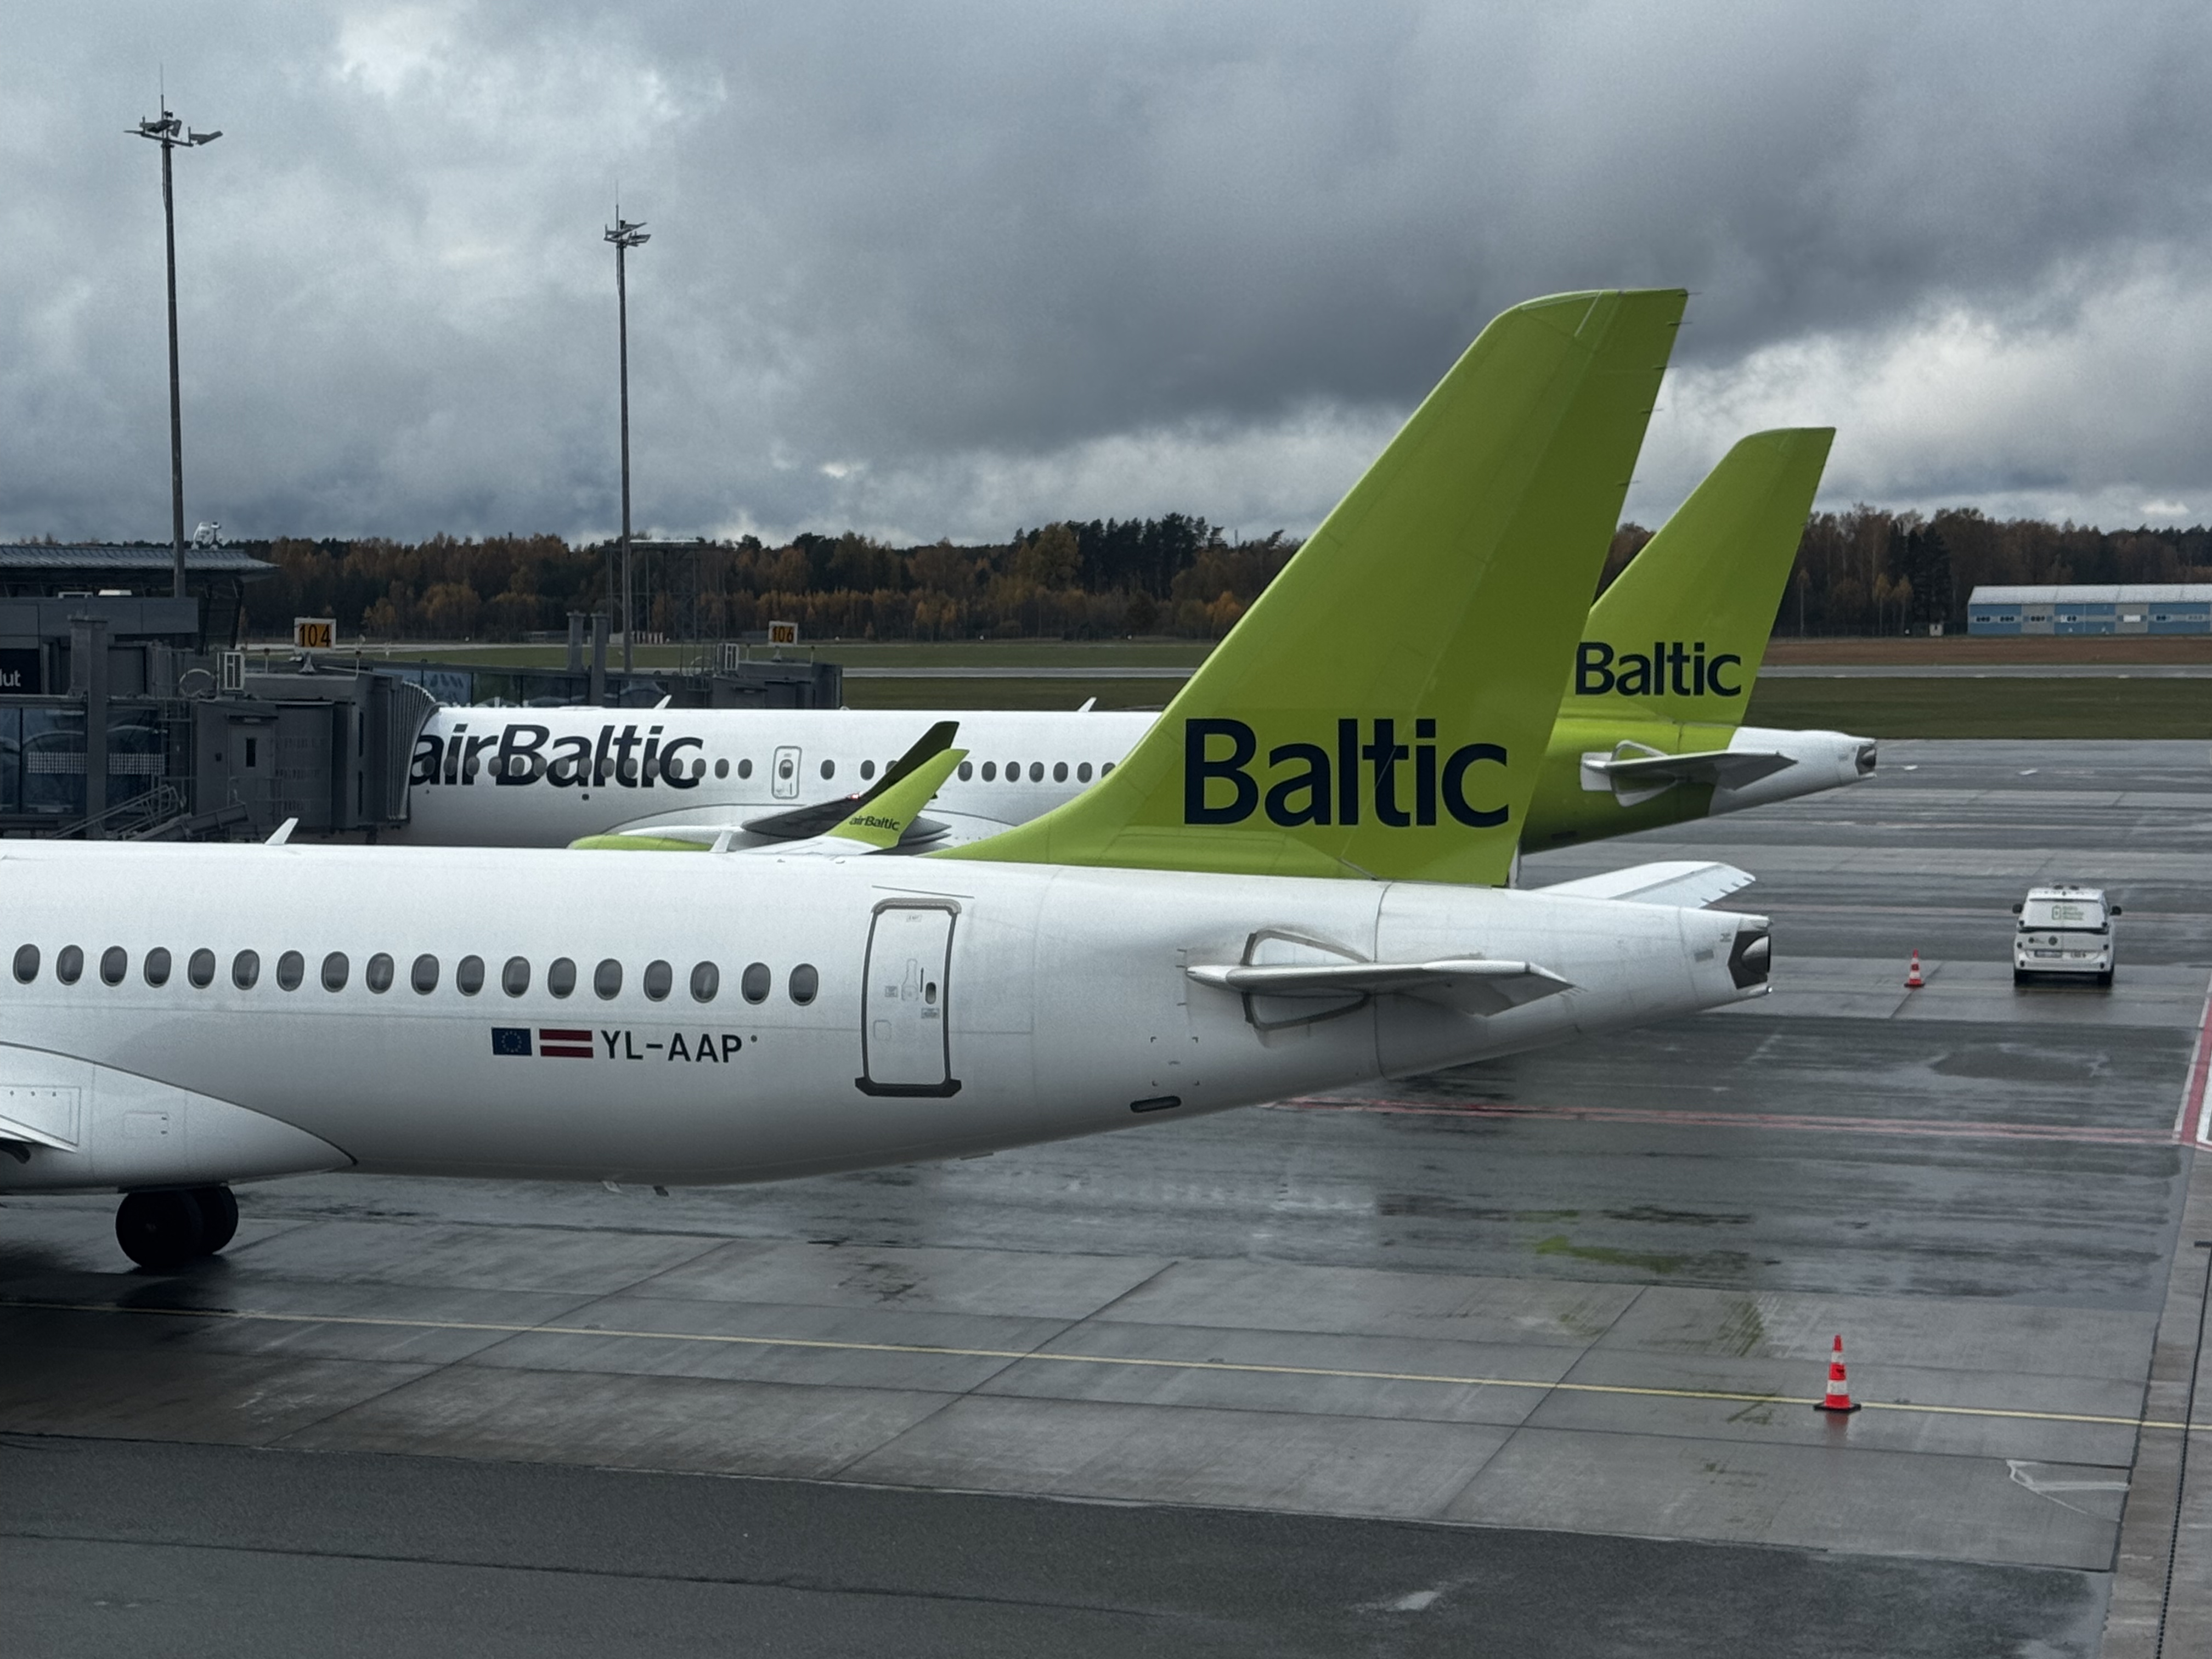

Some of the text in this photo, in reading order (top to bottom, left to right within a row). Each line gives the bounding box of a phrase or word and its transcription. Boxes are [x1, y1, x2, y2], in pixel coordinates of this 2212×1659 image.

[299, 624, 331, 647] 104
[772, 626, 794, 643] 106
[1575, 641, 1741, 697] Baltic
[409, 723, 704, 789] airBaltic
[1184, 718, 1509, 828] Baltic
[849, 815, 900, 831] airBaltic
[600, 1029, 742, 1063] YL-AAP
